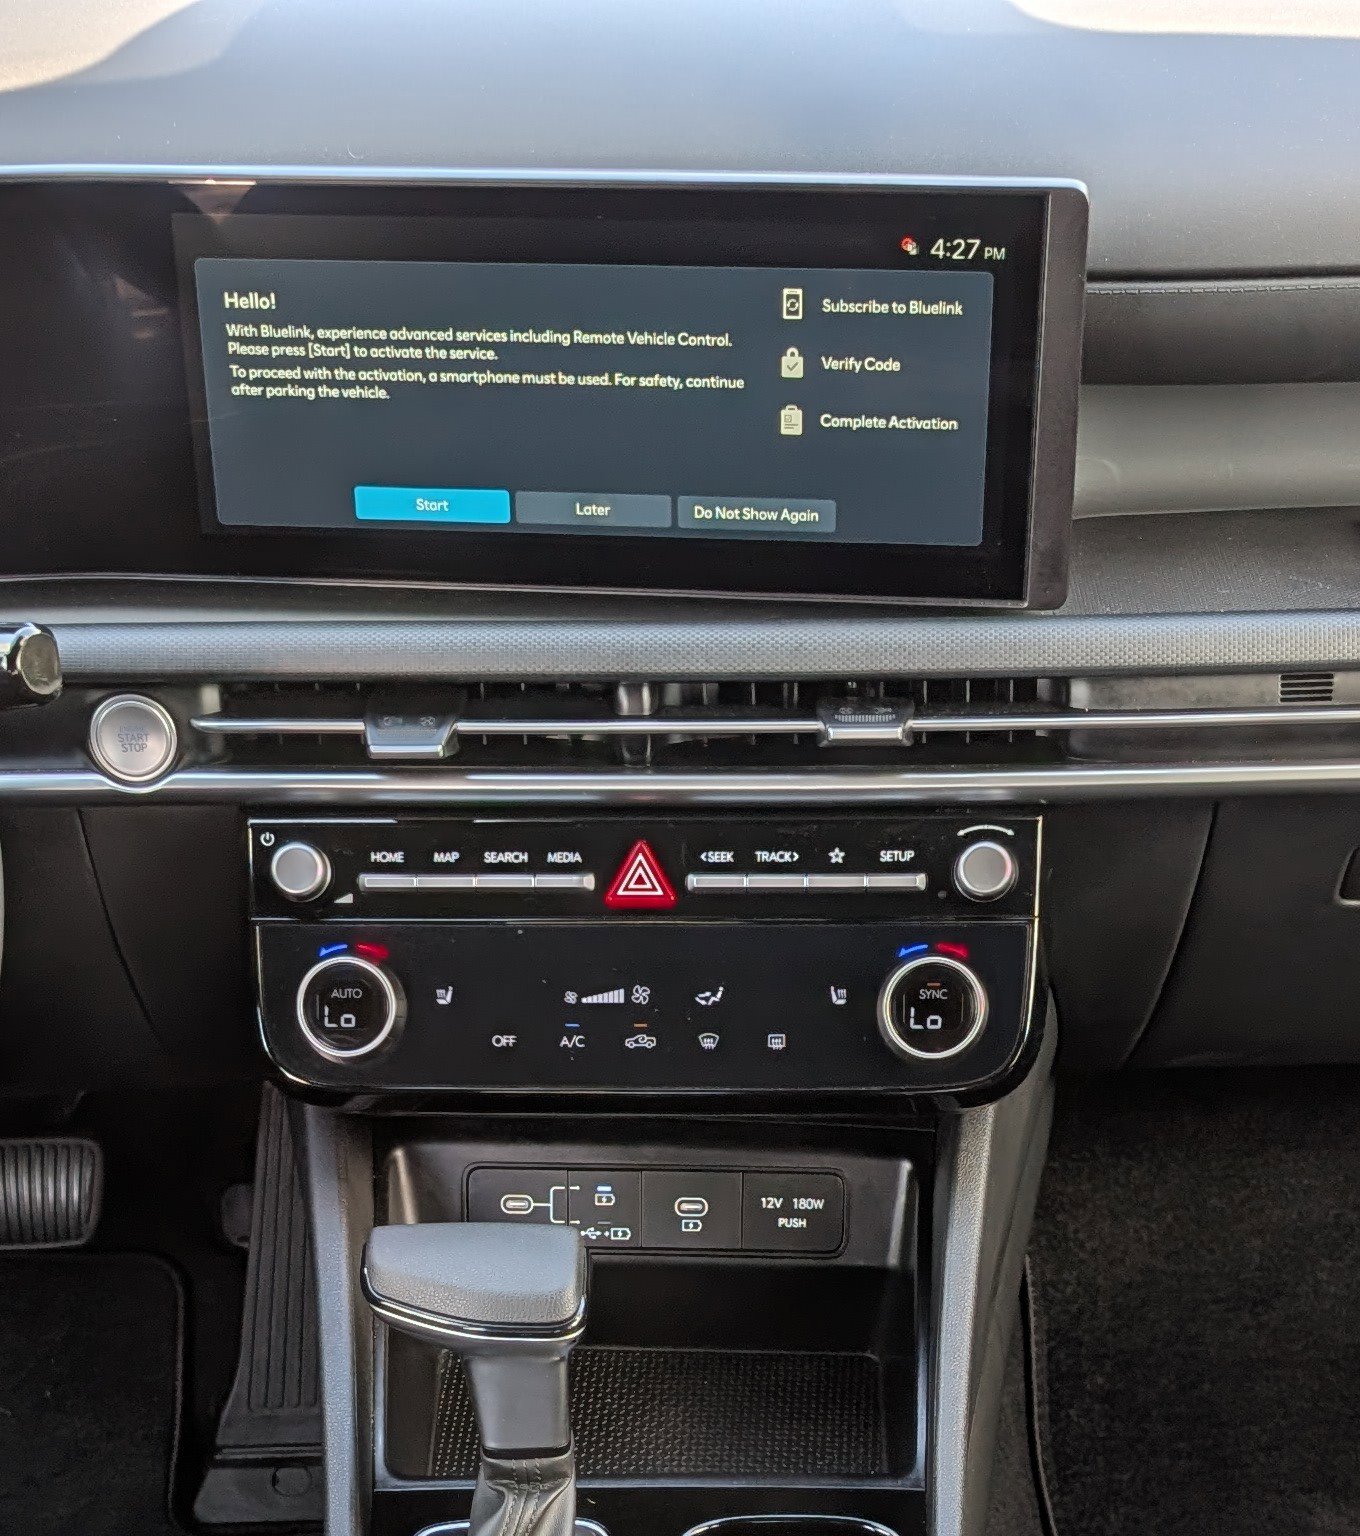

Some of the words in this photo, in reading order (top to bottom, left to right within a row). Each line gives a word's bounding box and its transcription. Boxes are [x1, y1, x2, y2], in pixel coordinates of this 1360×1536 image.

[930, 238, 981, 260] 4:27
[984, 247, 1006, 260] PM
[223, 291, 276, 310] Hello!
[822, 299, 889, 314] Subscribe
[892, 300, 906, 314] to
[909, 300, 963, 316] Bluelink
[226, 323, 258, 338] With
[261, 324, 314, 341] Bluelink,
[317, 327, 387, 342] experience
[390, 327, 452, 342] advanced
[456, 329, 507, 342] services
[510, 329, 570, 346] including
[574, 330, 624, 345] Remote
[627, 331, 675, 346] Vehicle
[678, 332, 732, 347] Control.
[227, 342, 269, 356] Please
[272, 346, 305, 359] press
[308, 343, 350, 360] [Start]
[353, 345, 368, 358] to
[371, 346, 422, 359] activate
[425, 346, 447, 359] the
[450, 347, 498, 361] service.
[821, 356, 861, 373] Verify
[864, 357, 900, 372] Code
[229, 365, 246, 378] To
[249, 367, 301, 381] proceed
[304, 367, 331, 380] with
[335, 367, 355, 380] the
[359, 368, 426, 384] activation,
[429, 373, 438, 382] a
[440, 371, 520, 386] smartphone
[522, 373, 556, 386] must
[558, 372, 575, 386] be
[578, 373, 612, 387] used.
[615, 373, 636, 387] For
[639, 373, 683, 391] safety,
[686, 376, 745, 389] continue
[231, 384, 263, 397] after
[266, 385, 315, 400] parking
[318, 386, 339, 398] the
[341, 387, 390, 400] vehicle.
[820, 414, 886, 430] Complete
[889, 415, 958, 431] Activation
[416, 498, 449, 513] Start
[575, 502, 611, 517] Later
[694, 505, 712, 520] Do
[715, 506, 740, 521] Not
[742, 507, 778, 522] Show
[780, 508, 819, 524] Again
[117, 733, 150, 743] START
[121, 743, 148, 753] STOP
[370, 852, 405, 863] HOME
[433, 852, 460, 863] MAP
[484, 852, 528, 863] SEARCH
[547, 852, 583, 863] MEDIA
[880, 850, 915, 862] SETUP
[331, 988, 363, 999] AUTO
[919, 989, 948, 999] SYNC
[491, 1034, 517, 1047] OFF
[559, 1035, 585, 1048] A/C
[761, 1197, 784, 1209] 12V
[792, 1197, 825, 1210] 180W
[777, 1217, 807, 1228] PUSH
